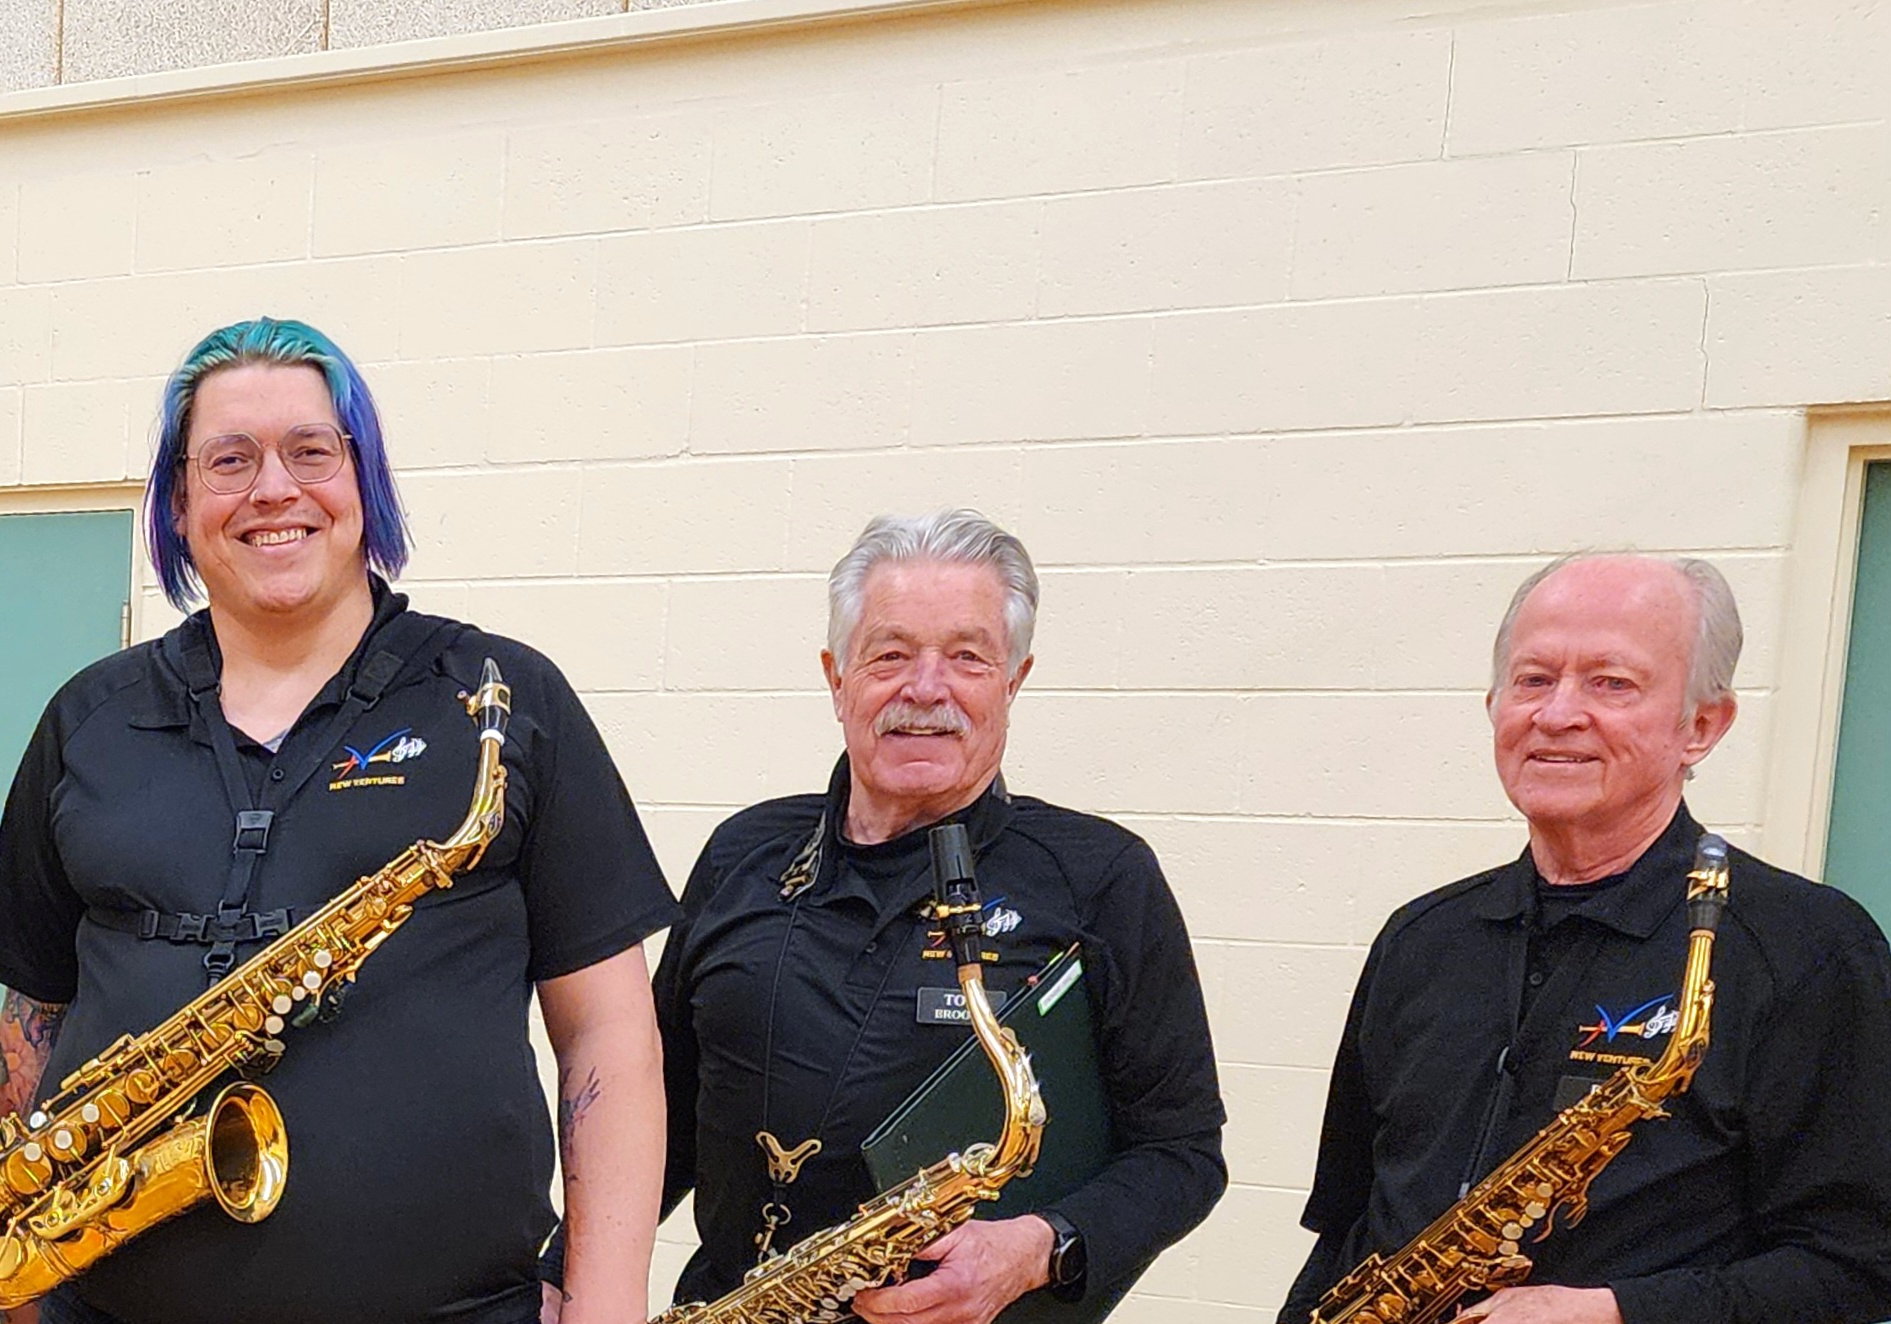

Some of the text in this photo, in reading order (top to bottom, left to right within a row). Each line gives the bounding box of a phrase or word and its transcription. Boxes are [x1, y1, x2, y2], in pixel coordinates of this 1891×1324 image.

[329, 776, 405, 791] NEW VENTURES
[943, 993, 966, 1007] TO
[935, 1009, 971, 1020] BROO
[1569, 1050, 1596, 1062] NEW
